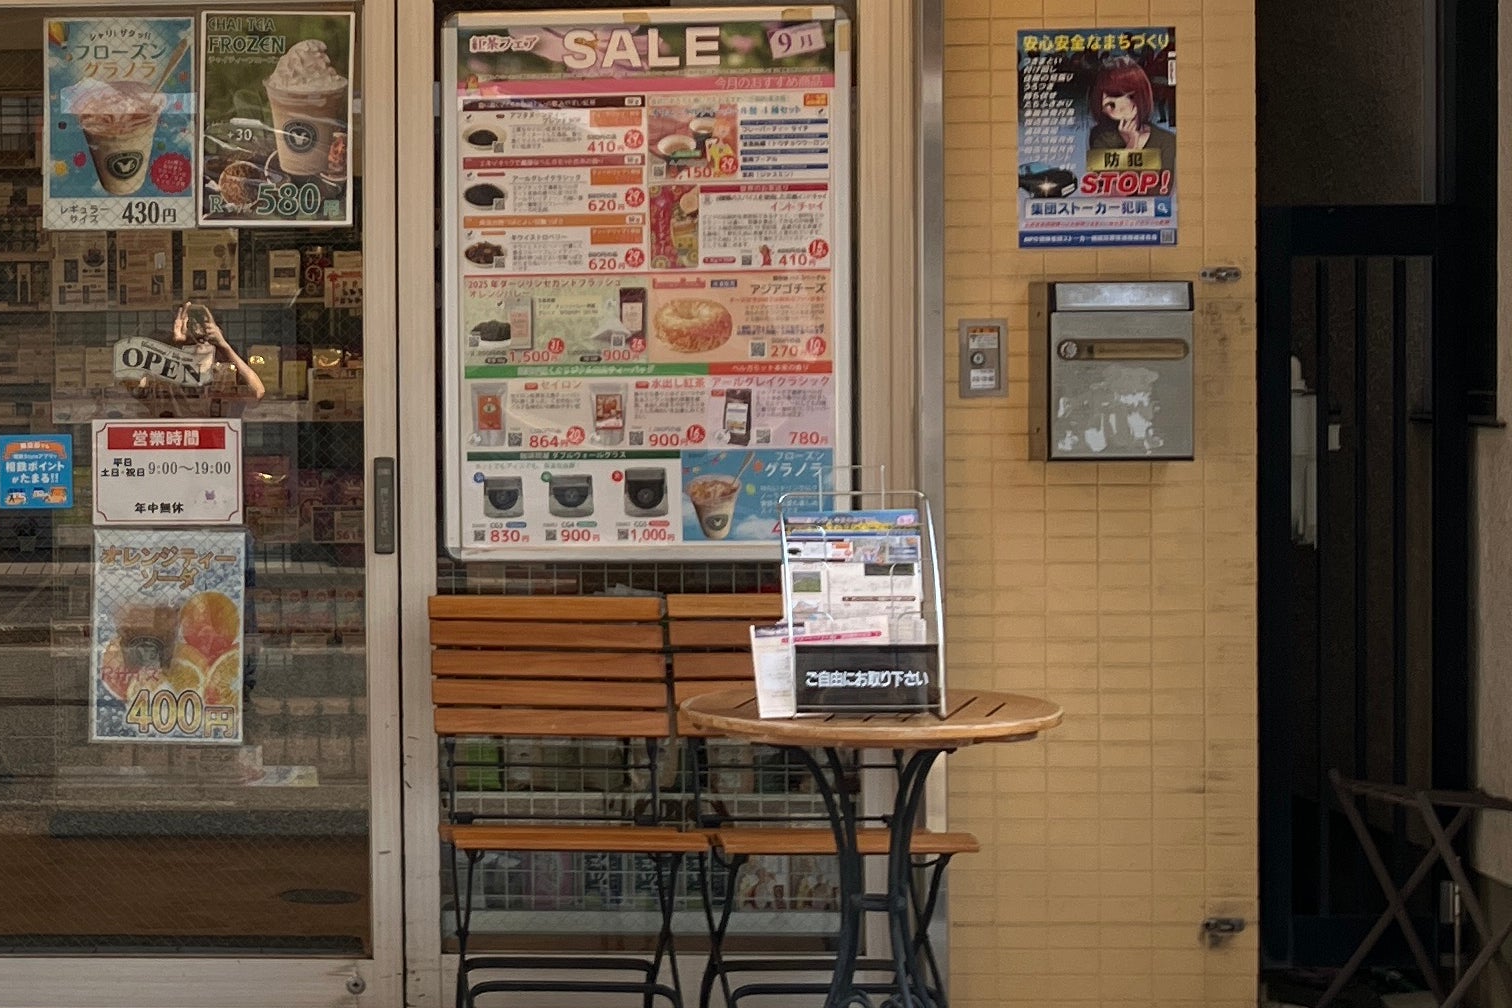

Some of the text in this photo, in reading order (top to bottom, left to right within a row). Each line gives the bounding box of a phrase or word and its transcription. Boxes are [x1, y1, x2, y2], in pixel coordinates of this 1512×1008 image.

[208, 17, 276, 32] CHAI TEA
[208, 35, 286, 54] FROZEN
[469, 27, 814, 70] 紅茶フェア SALE 9月
[1023, 34, 1169, 52] 安心安全なまちづくり
[77, 43, 167, 60] フローズン
[84, 61, 157, 79] グラノラ
[715, 75, 823, 90] 今月のおすすめ商品
[1104, 152, 1143, 168] 防犯
[1080, 171, 1171, 195] STOP!
[59, 204, 109, 215] レギュラー
[122, 201, 177, 224] 430円
[1030, 201, 1149, 216] 集団ストーカー犯罪
[70, 214, 100, 224] サイズ
[750, 283, 827, 295] アジアゴチーズ
[122, 347, 201, 383] OPEN
[541, 381, 583, 389] セイロン
[651, 378, 706, 389] 水出し紅茶
[712, 377, 830, 387] アールグレイクラシック
[132, 430, 200, 447] 営業時間
[113, 458, 133, 467] 平日
[765, 462, 822, 477] グラノラ
[134, 502, 185, 514] 年中無休
[102, 545, 237, 570] オレンジティー
[141, 568, 199, 589] ソーダ
[805, 671, 929, 688] ご自由にお取り下さい
[126, 689, 235, 738] 400円
